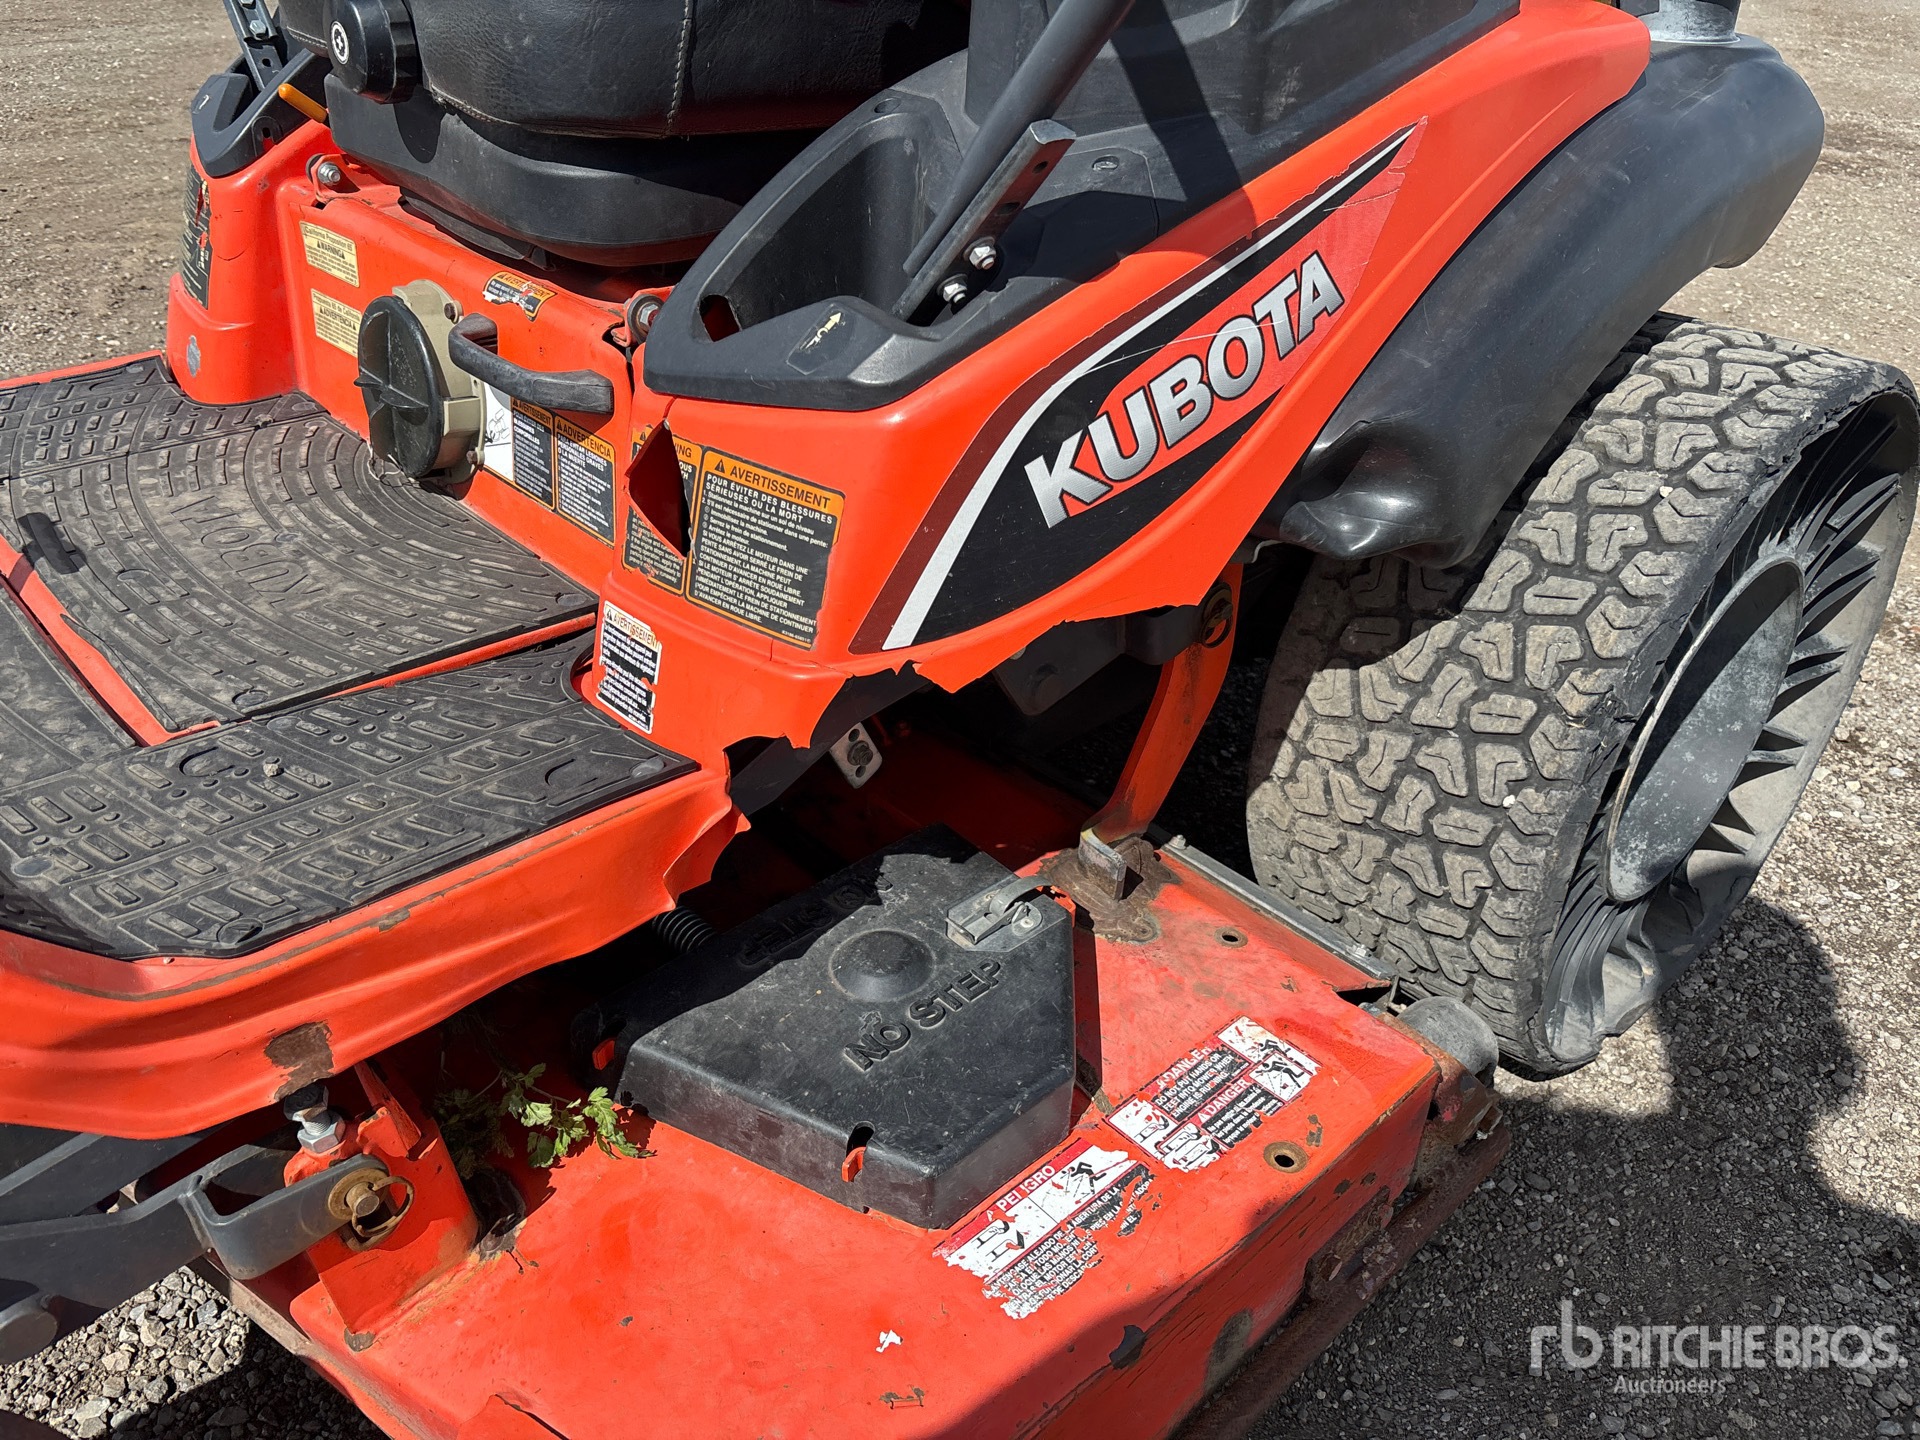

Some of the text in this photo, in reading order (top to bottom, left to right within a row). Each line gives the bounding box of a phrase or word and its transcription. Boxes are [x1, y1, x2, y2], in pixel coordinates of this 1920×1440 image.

[1024, 250, 1344, 529] KUBOTA
[563, 424, 612, 459] ADVERTENCIA
[705, 481, 803, 523] SÉRIEUSES OU LA MORT
[706, 473, 832, 524] POUR ÉVITER DES BLESSURES
[730, 465, 830, 509] AVERTISSEMENT
[708, 491, 733, 505] Stationnez
[738, 503, 760, 515] machine
[778, 517, 787, 525] sol
[787, 520, 795, 528] de
[795, 523, 814, 535] niveau
[714, 502, 722, 510] est
[723, 505, 749, 520] nécessaire
[757, 518, 783, 532] stationner
[784, 527, 797, 537] dans
[798, 533, 809, 541] une
[810, 536, 828, 549] pente:
[699, 553, 727, 568] CONTINUER
[728, 564, 757, 580] D'AVANCER
[758, 575, 766, 583] EN
[766, 579, 783, 590] ROUE
[783, 585, 802, 597] LIBRE.
[701, 537, 802, 581] PENTE SANS AVOIR SERRÉ LE FREIN DE
[708, 532, 722, 542] VOUS
[722, 537, 746, 551] ARRÊTEZ
[754, 549, 778, 563] MOTEUR
[778, 558, 794, 569] DANS
[795, 565, 808, 575] UNE
[742, 561, 749, 569] LA
[750, 564, 775, 579] MACHINE
[776, 574, 791, 585] PEUT
[694, 589, 762, 622] D'AVANCER EN ROUE LIBRE.
[704, 562, 710, 570] LE
[711, 565, 732, 578] MOTEUR
[738, 575, 759, 589] ARRÊTE
[760, 584, 804, 606] SOUDAINEMENT
[756, 591, 787, 608] APPLIQUER
[710, 588, 737, 603] EMPÊCHER
[746, 602, 770, 616] MACHINE
[770, 612, 778, 620] DE
[779, 615, 813, 633] CONTINUER
[736, 590, 816, 626] LE FREIN DE STATIONNEMENT
[844, 960, 1001, 1072] NO STEP
[1155, 1052, 1221, 1105] DO NOT PUT HANDS OR
[1162, 1096, 1181, 1111] FEET
[1177, 1084, 1195, 1099] INTO
[1214, 1054, 1234, 1070] WHEN
[1208, 1078, 1250, 1115] DANGER
[1170, 1090, 1203, 1117] ENGINE IS
[1025, 1186, 1119, 1261] ALEJADO DE ABERTURA DE LA
[1037, 1262, 1053, 1275] LAS
[1089, 1218, 1106, 1231] PIES
[1102, 1211, 1114, 1220] EN
[1110, 1205, 1122, 1213] LA
[1033, 1250, 1054, 1266] TODO
[1034, 1277, 1047, 1288] EL
[1042, 1260, 1068, 1281] MOTOR
[1071, 1258, 1084, 1268] LA
